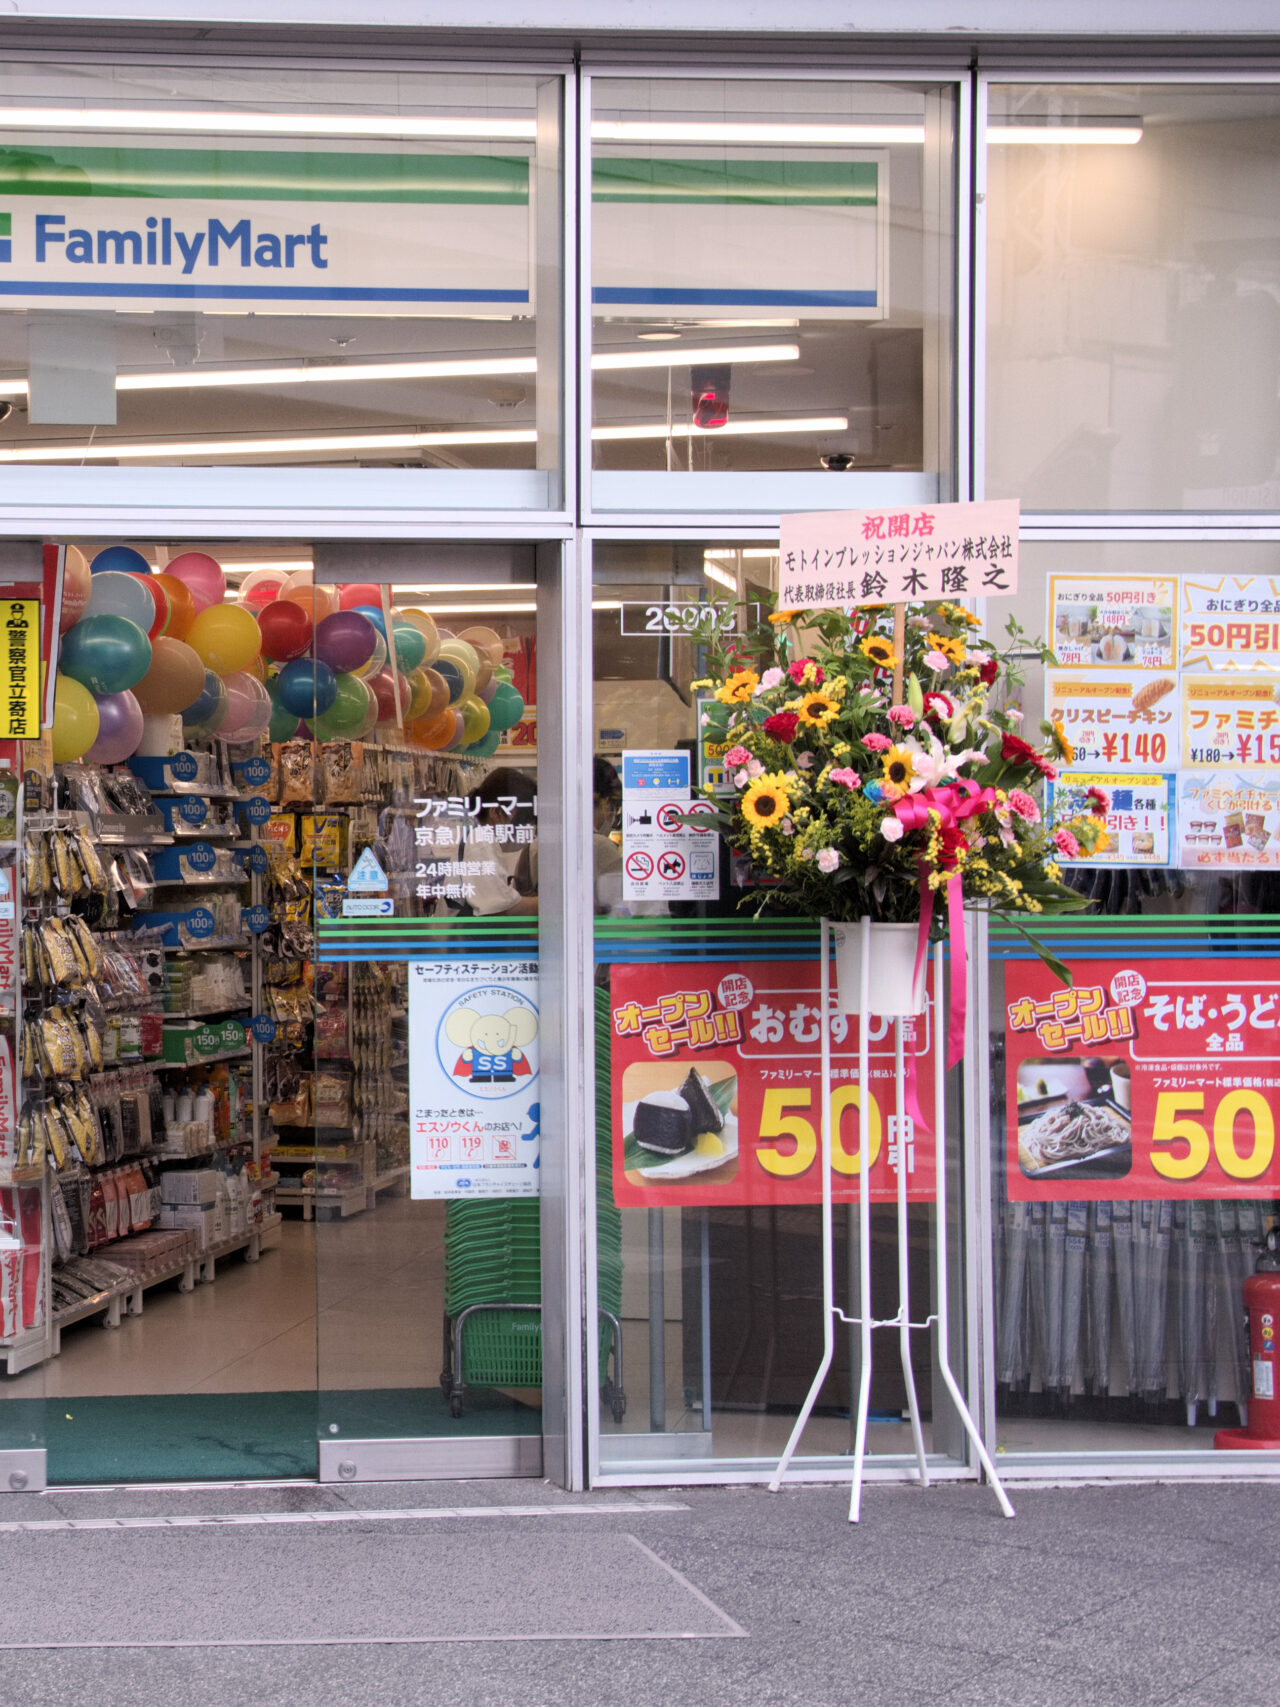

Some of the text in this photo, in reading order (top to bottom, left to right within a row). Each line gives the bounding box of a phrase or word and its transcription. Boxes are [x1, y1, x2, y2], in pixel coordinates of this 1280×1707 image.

[35, 213, 328, 274] FamilyMart
[861, 512, 936, 541] 祝開店
[784, 535, 1013, 573] モトインプレッションジャパン株式会社
[783, 562, 1010, 605] 代表取締役社長 鈴木隆之
[1057, 592, 1157, 604] おにぎり全品 50円引き
[1102, 614, 1126, 625] 148円
[1061, 652, 1081, 663] 78円
[1142, 656, 1163, 666] 74円
[8, 630, 27, 735] 警察官立寄店
[1051, 708, 1173, 724] クリスピーチキン
[1102, 732, 1166, 764] ¥140
[1190, 748, 1220, 763] ¥180
[1134, 799, 1156, 811] 各種
[414, 823, 535, 846] 京急川崎駅前
[415, 861, 497, 877] 24時間営業
[416, 884, 477, 900] 年中無休
[721, 976, 748, 992] 開店
[1114, 974, 1140, 989] 開店
[458, 989, 526, 1008] SAFETY STATION
[723, 991, 750, 1007] 記念
[1117, 988, 1144, 1003] 記念
[615, 990, 712, 1035] オープン
[1008, 986, 1107, 1030] オープン
[1143, 992, 1280, 1031] そば・うど
[644, 1009, 741, 1056] セール!!
[1036, 1004, 1135, 1051] セール!!
[1206, 1033, 1244, 1052] 全品
[478, 1055, 508, 1072] SS
[416, 1120, 523, 1134] エスゾウくんのお店へ!
[756, 1084, 882, 1177] 50
[1149, 1088, 1275, 1179] 50
[429, 1137, 481, 1149] 110 119
